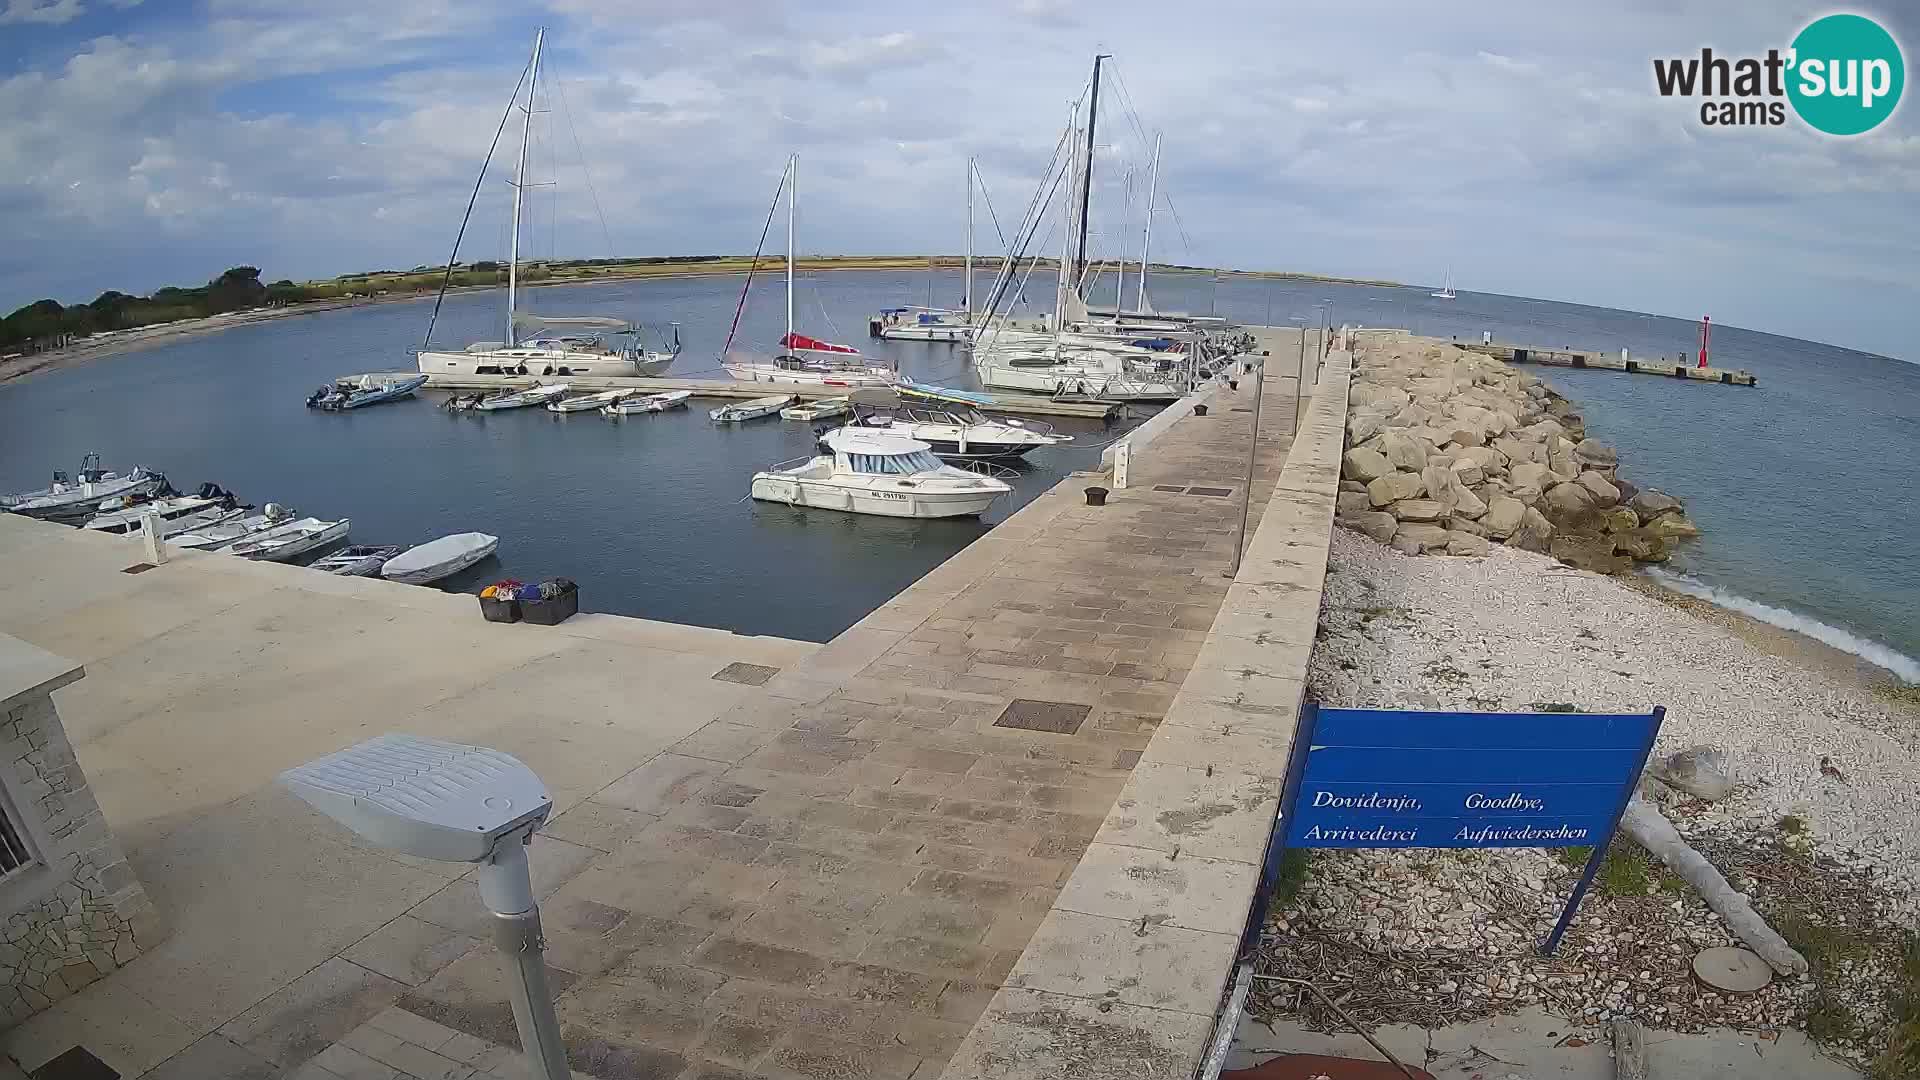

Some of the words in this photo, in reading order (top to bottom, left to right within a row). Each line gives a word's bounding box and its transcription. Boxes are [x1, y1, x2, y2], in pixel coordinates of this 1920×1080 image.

[1465, 793, 1545, 812] Goodbye,
[1304, 825, 1418, 841] Arrivederci
[1453, 824, 1588, 844] Aufwiedersehen
